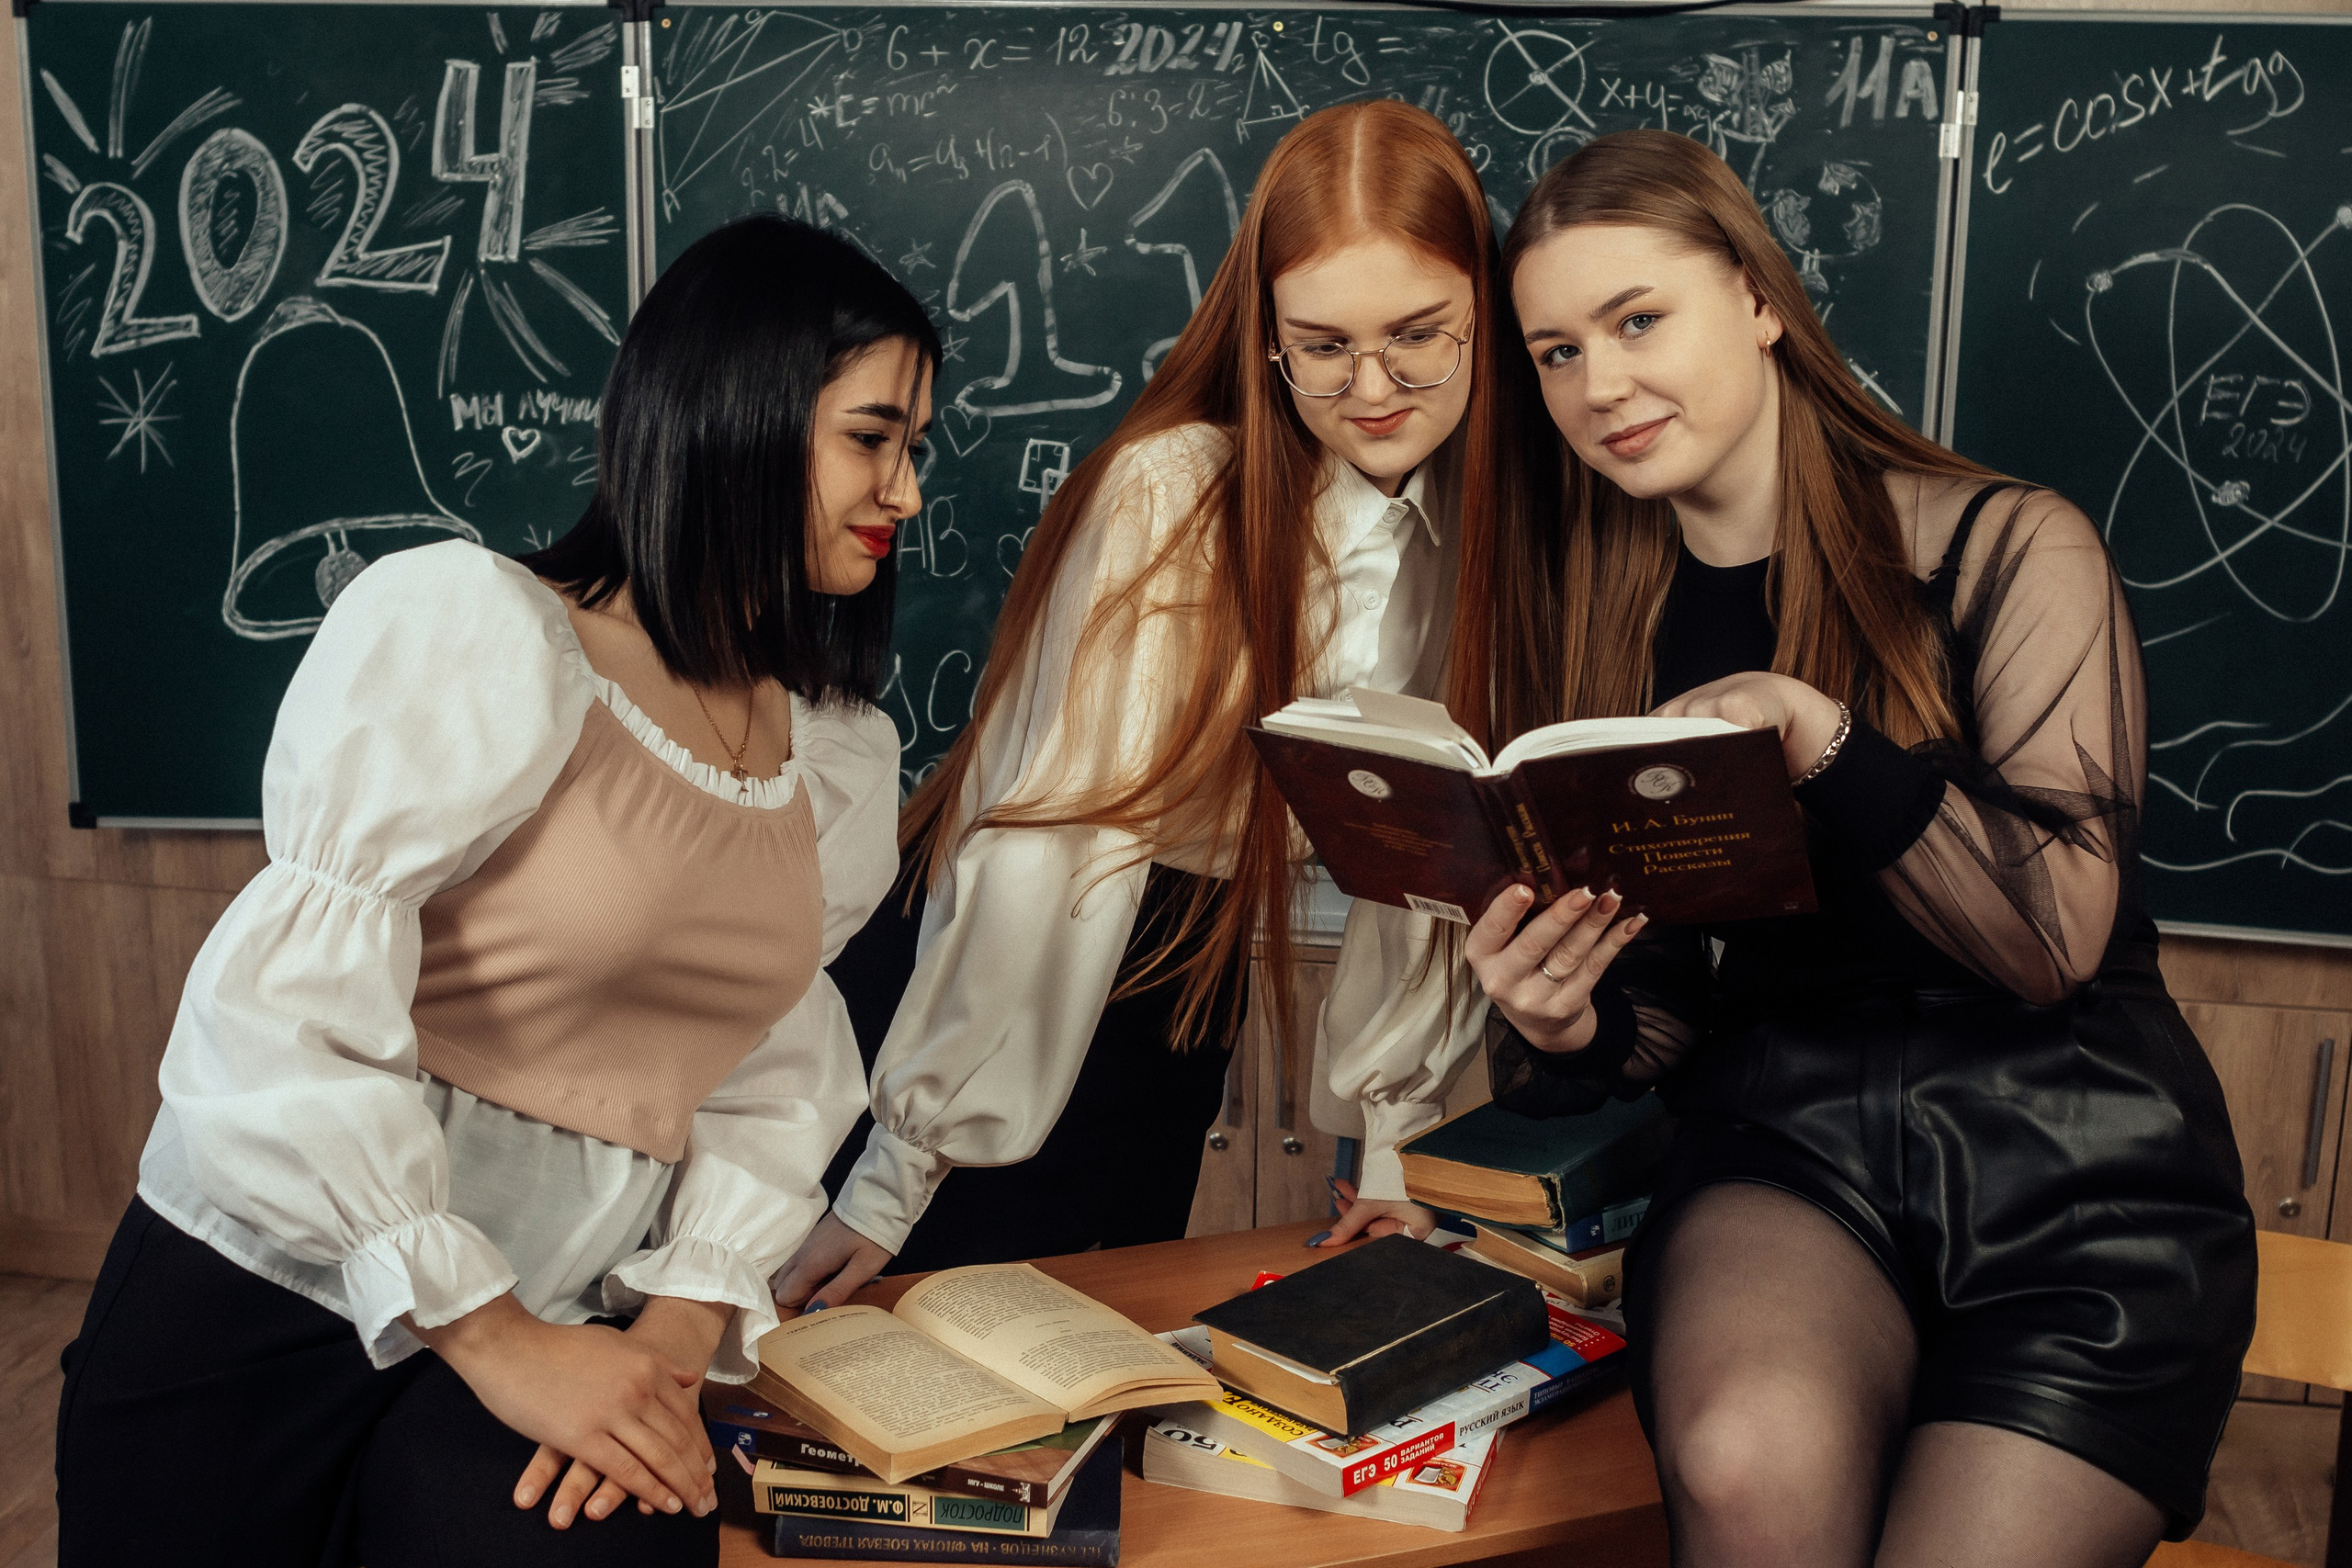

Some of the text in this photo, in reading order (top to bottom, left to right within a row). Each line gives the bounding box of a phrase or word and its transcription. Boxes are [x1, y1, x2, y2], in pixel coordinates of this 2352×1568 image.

[888, 25, 909, 70] 6
[1046, 24, 1099, 65] 12
[1103, 22, 1242, 75] 2024
[67, 57, 538, 358] 2024
[2199, 374, 2312, 426] ЕГЭ
[1672, 811, 1734, 826] Бунин
[1609, 831, 1751, 854] Стихотворения
[1644, 847, 1724, 863] Повести
[1643, 859, 1732, 874] Рассказы
[1238, 1404, 1304, 1437] СОЗДАНО
[1459, 1400, 1525, 1436] РУССКИЙ ЯЗЫК
[1384, 1432, 1444, 1472] 50 ВАРИАНТОВ
[1400, 1443, 1435, 1464] ЗАДАНИЙ
[1353, 1463, 1376, 1485] ЕГЭ
[967, 1478, 980, 1486] МГУ
[984, 1481, 1005, 1492] ШКОЛЕ
[775, 1492, 904, 1515] Ф.М. ДОСТОЕВСКИЙ
[940, 1503, 1024, 1524] ПОДРОСТОК
[798, 1533, 854, 1550] ТРЕВОГА
[857, 1537, 910, 1551] БОЕВАЯ
[913, 1539, 967, 1553] ФЛОТАХ
[970, 1541, 989, 1554] НА
[1001, 1540, 1077, 1558] КУЗНЕЦОВ
